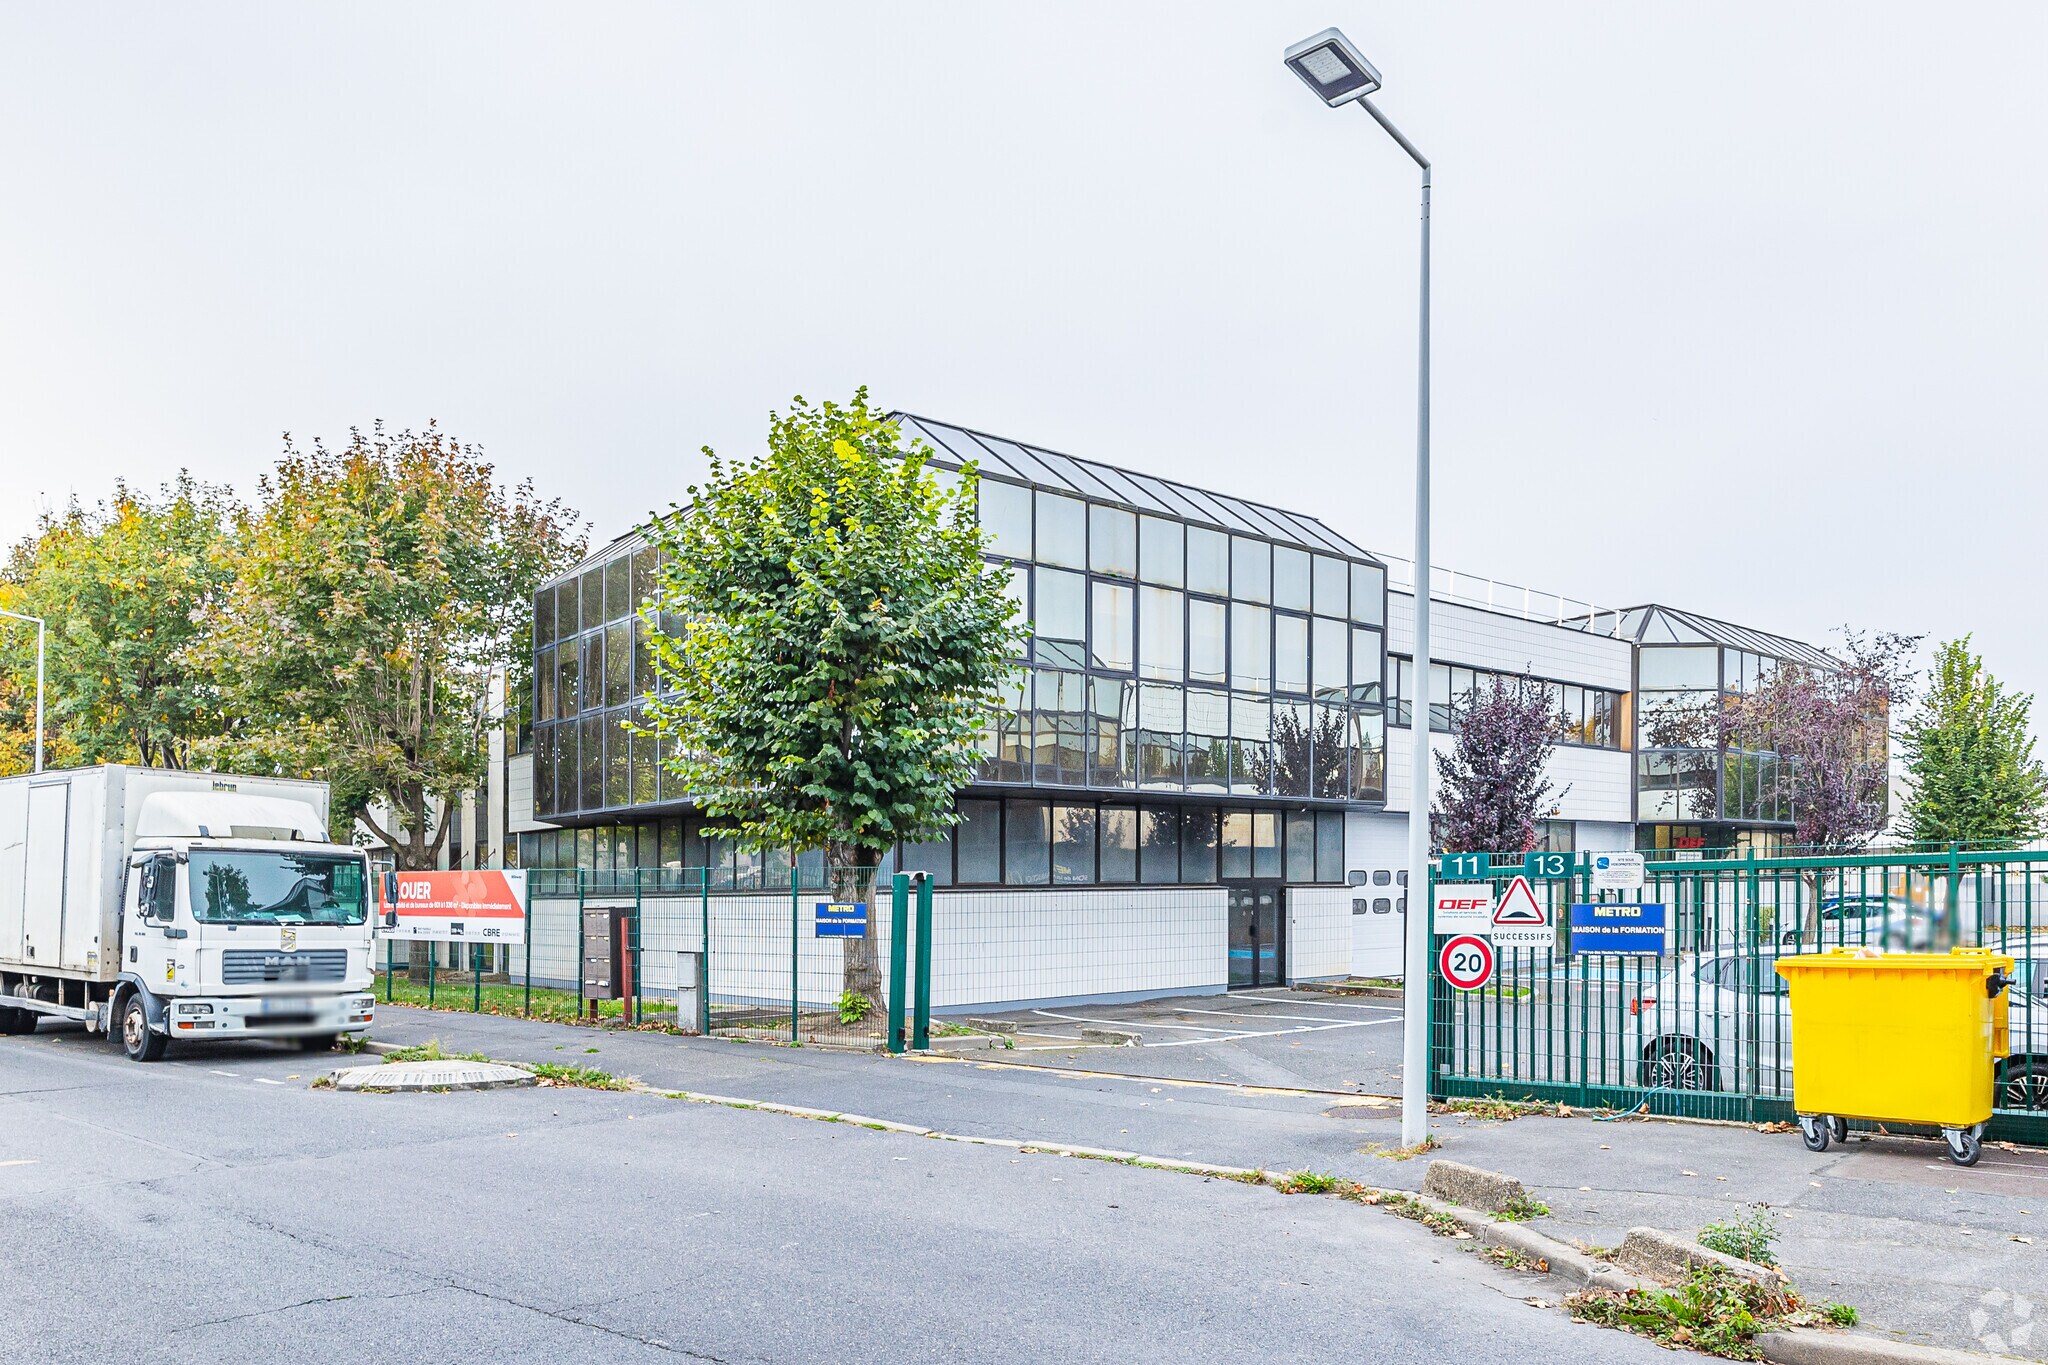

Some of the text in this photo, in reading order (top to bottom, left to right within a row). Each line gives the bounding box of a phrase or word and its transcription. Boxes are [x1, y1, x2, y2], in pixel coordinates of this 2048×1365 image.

[1452, 856, 1479, 876] 11
[1533, 855, 1565, 875] 13
[399, 881, 431, 900] OUER
[1594, 906, 1641, 917] METRO
[483, 928, 501, 937] CBRE
[1612, 926, 1619, 934] la
[1620, 926, 1665, 934] FORMATION
[1493, 932, 1552, 941] SUCCESSIFS
[264, 956, 310, 966] MAN
[1453, 953, 1482, 973] 20
